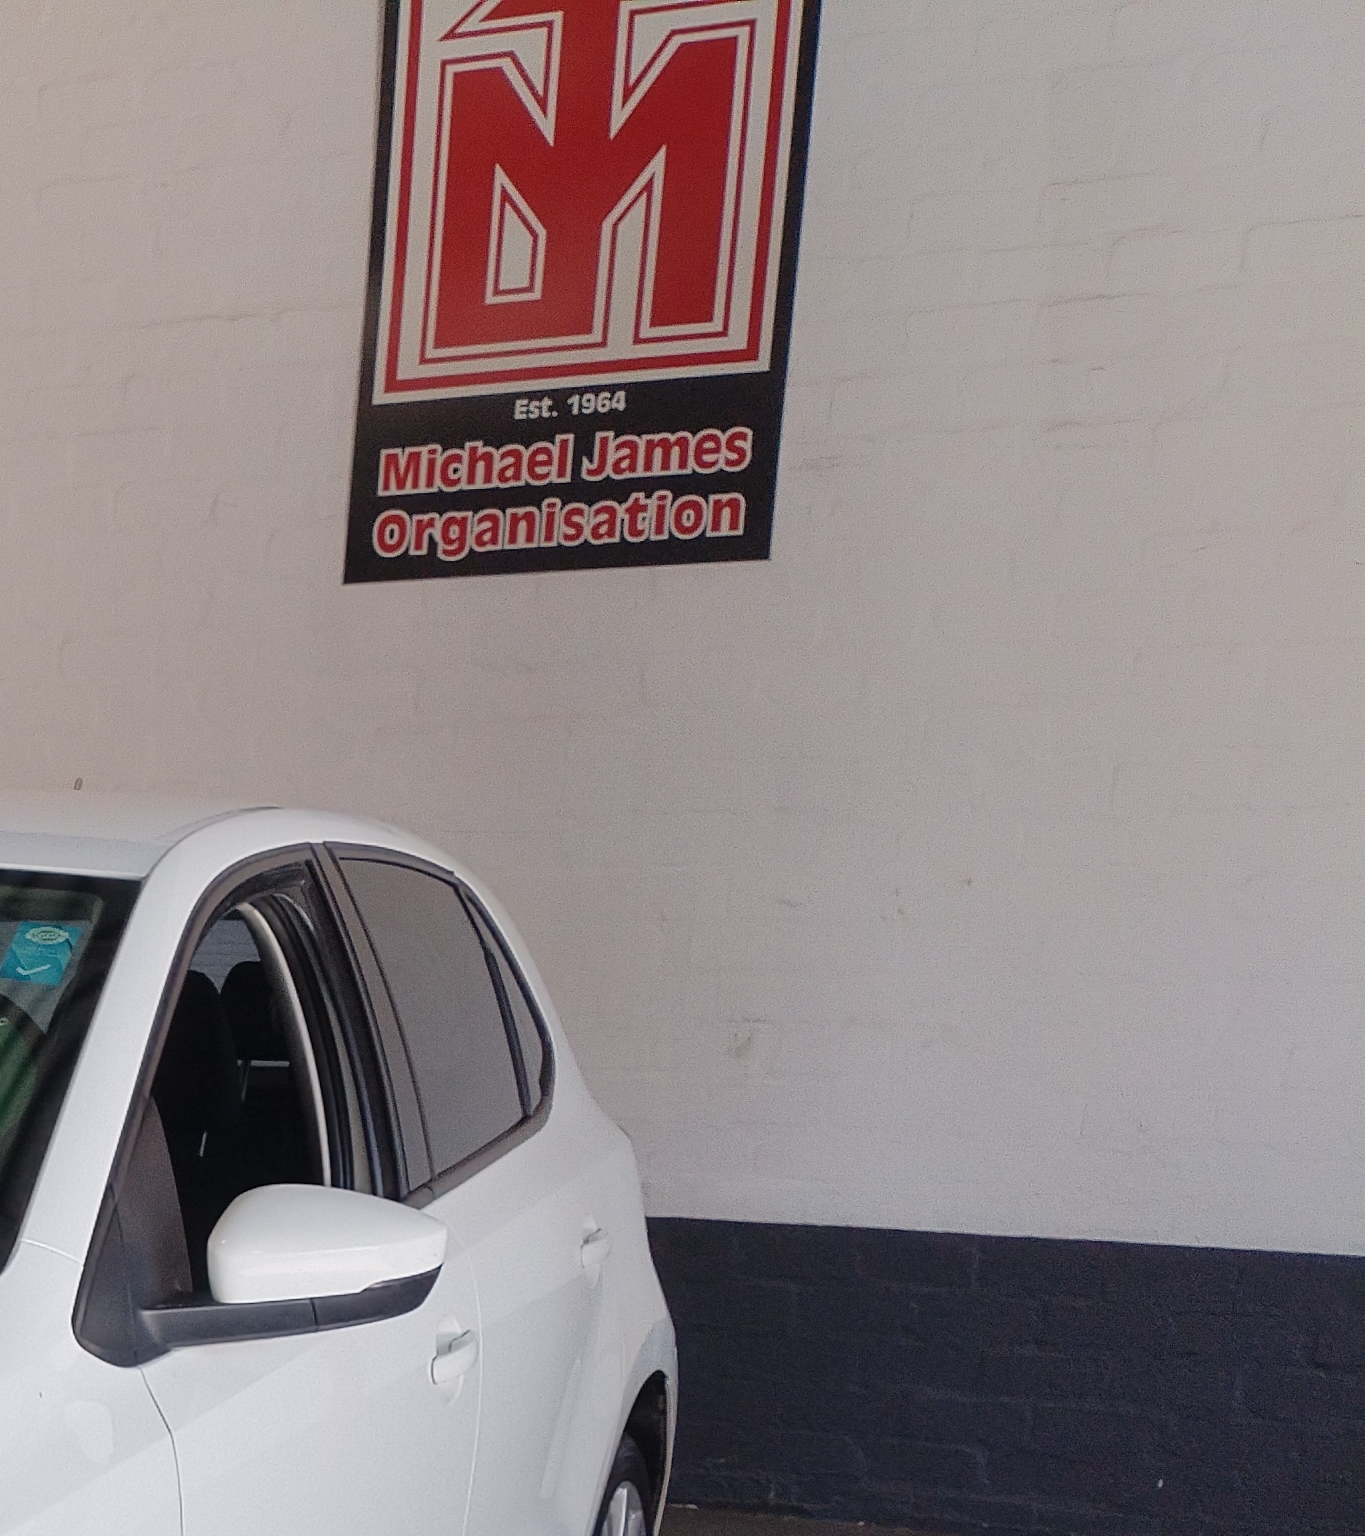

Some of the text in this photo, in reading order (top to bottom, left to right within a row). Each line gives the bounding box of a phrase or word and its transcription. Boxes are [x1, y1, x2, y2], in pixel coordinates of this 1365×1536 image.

[514, 390, 627, 421] Est. 1964
[377, 426, 754, 497] Michael James
[372, 489, 747, 562] Organisation
